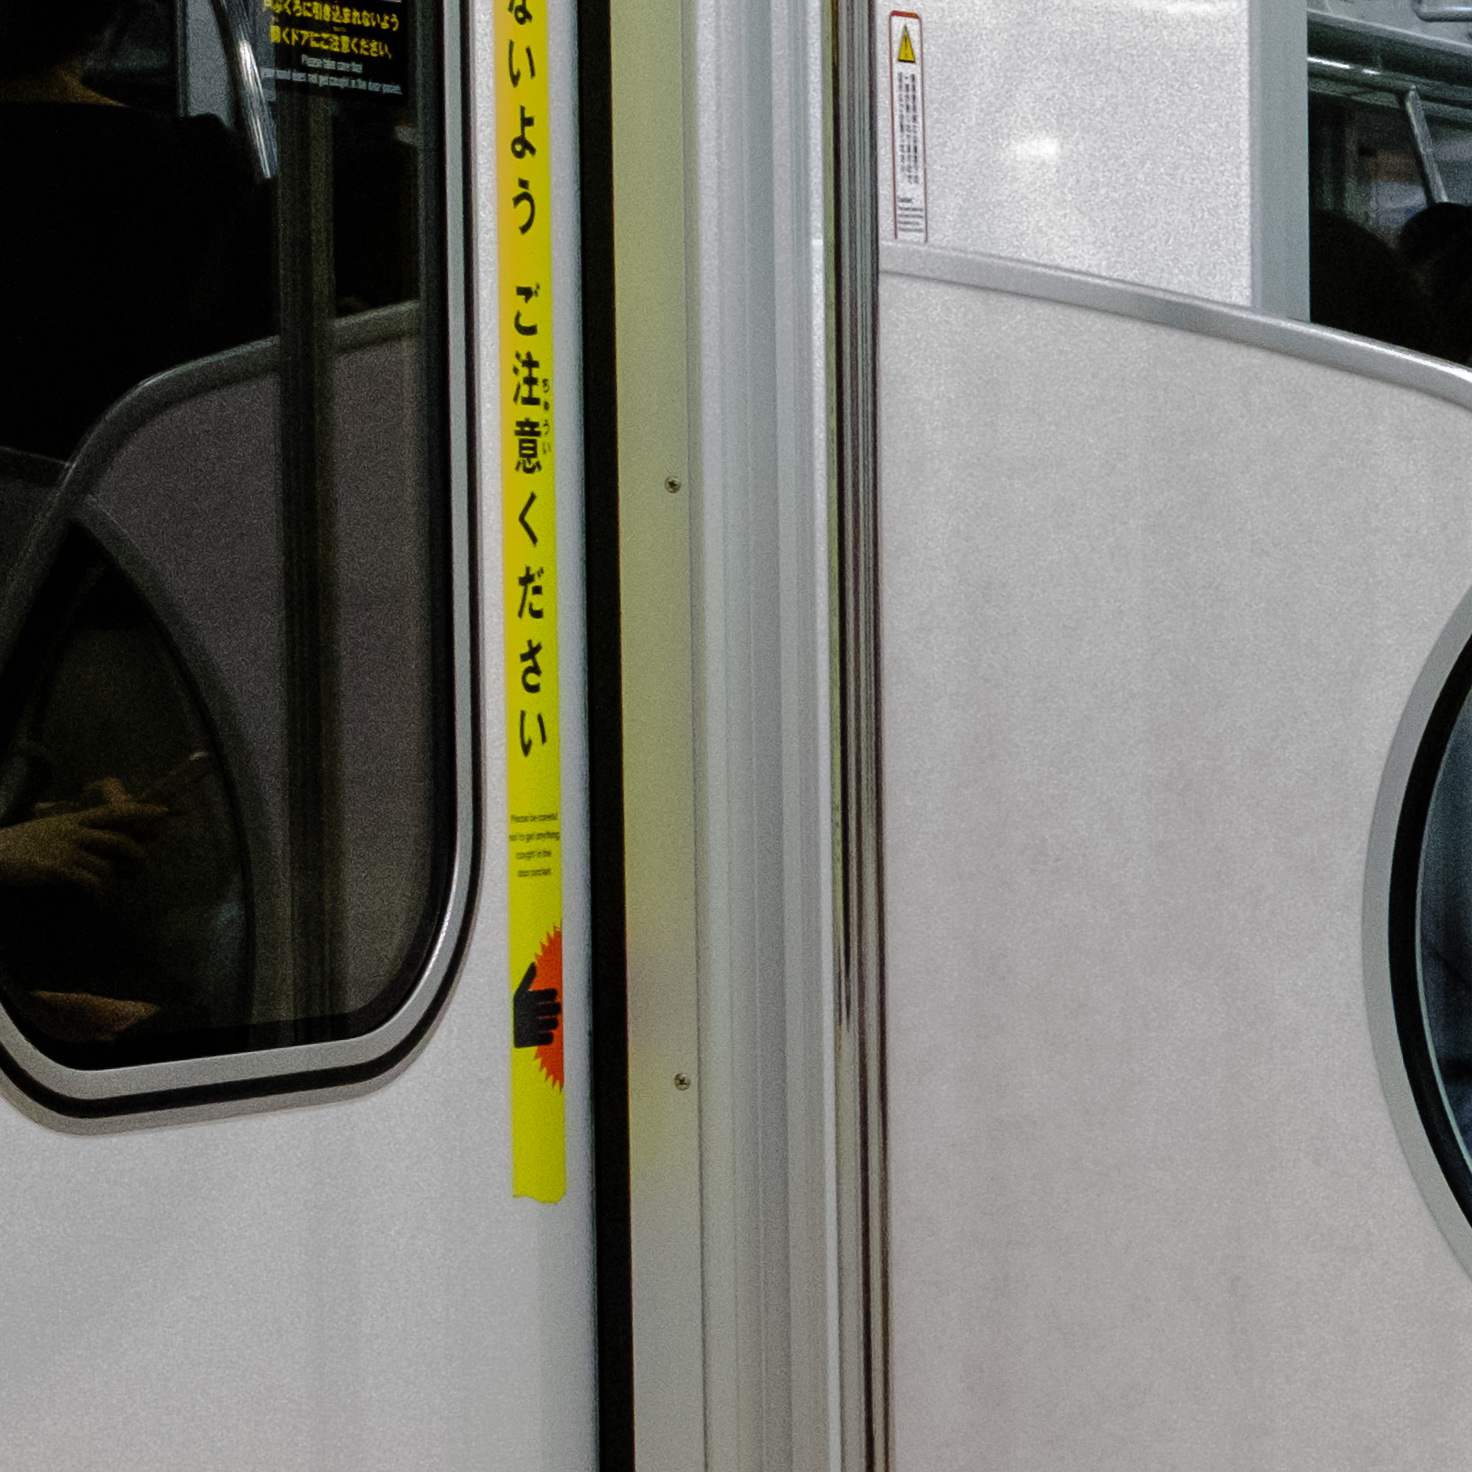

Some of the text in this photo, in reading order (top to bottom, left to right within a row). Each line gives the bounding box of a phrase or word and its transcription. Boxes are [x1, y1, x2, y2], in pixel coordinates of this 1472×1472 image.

[514, 282, 547, 757] ご注意ください
